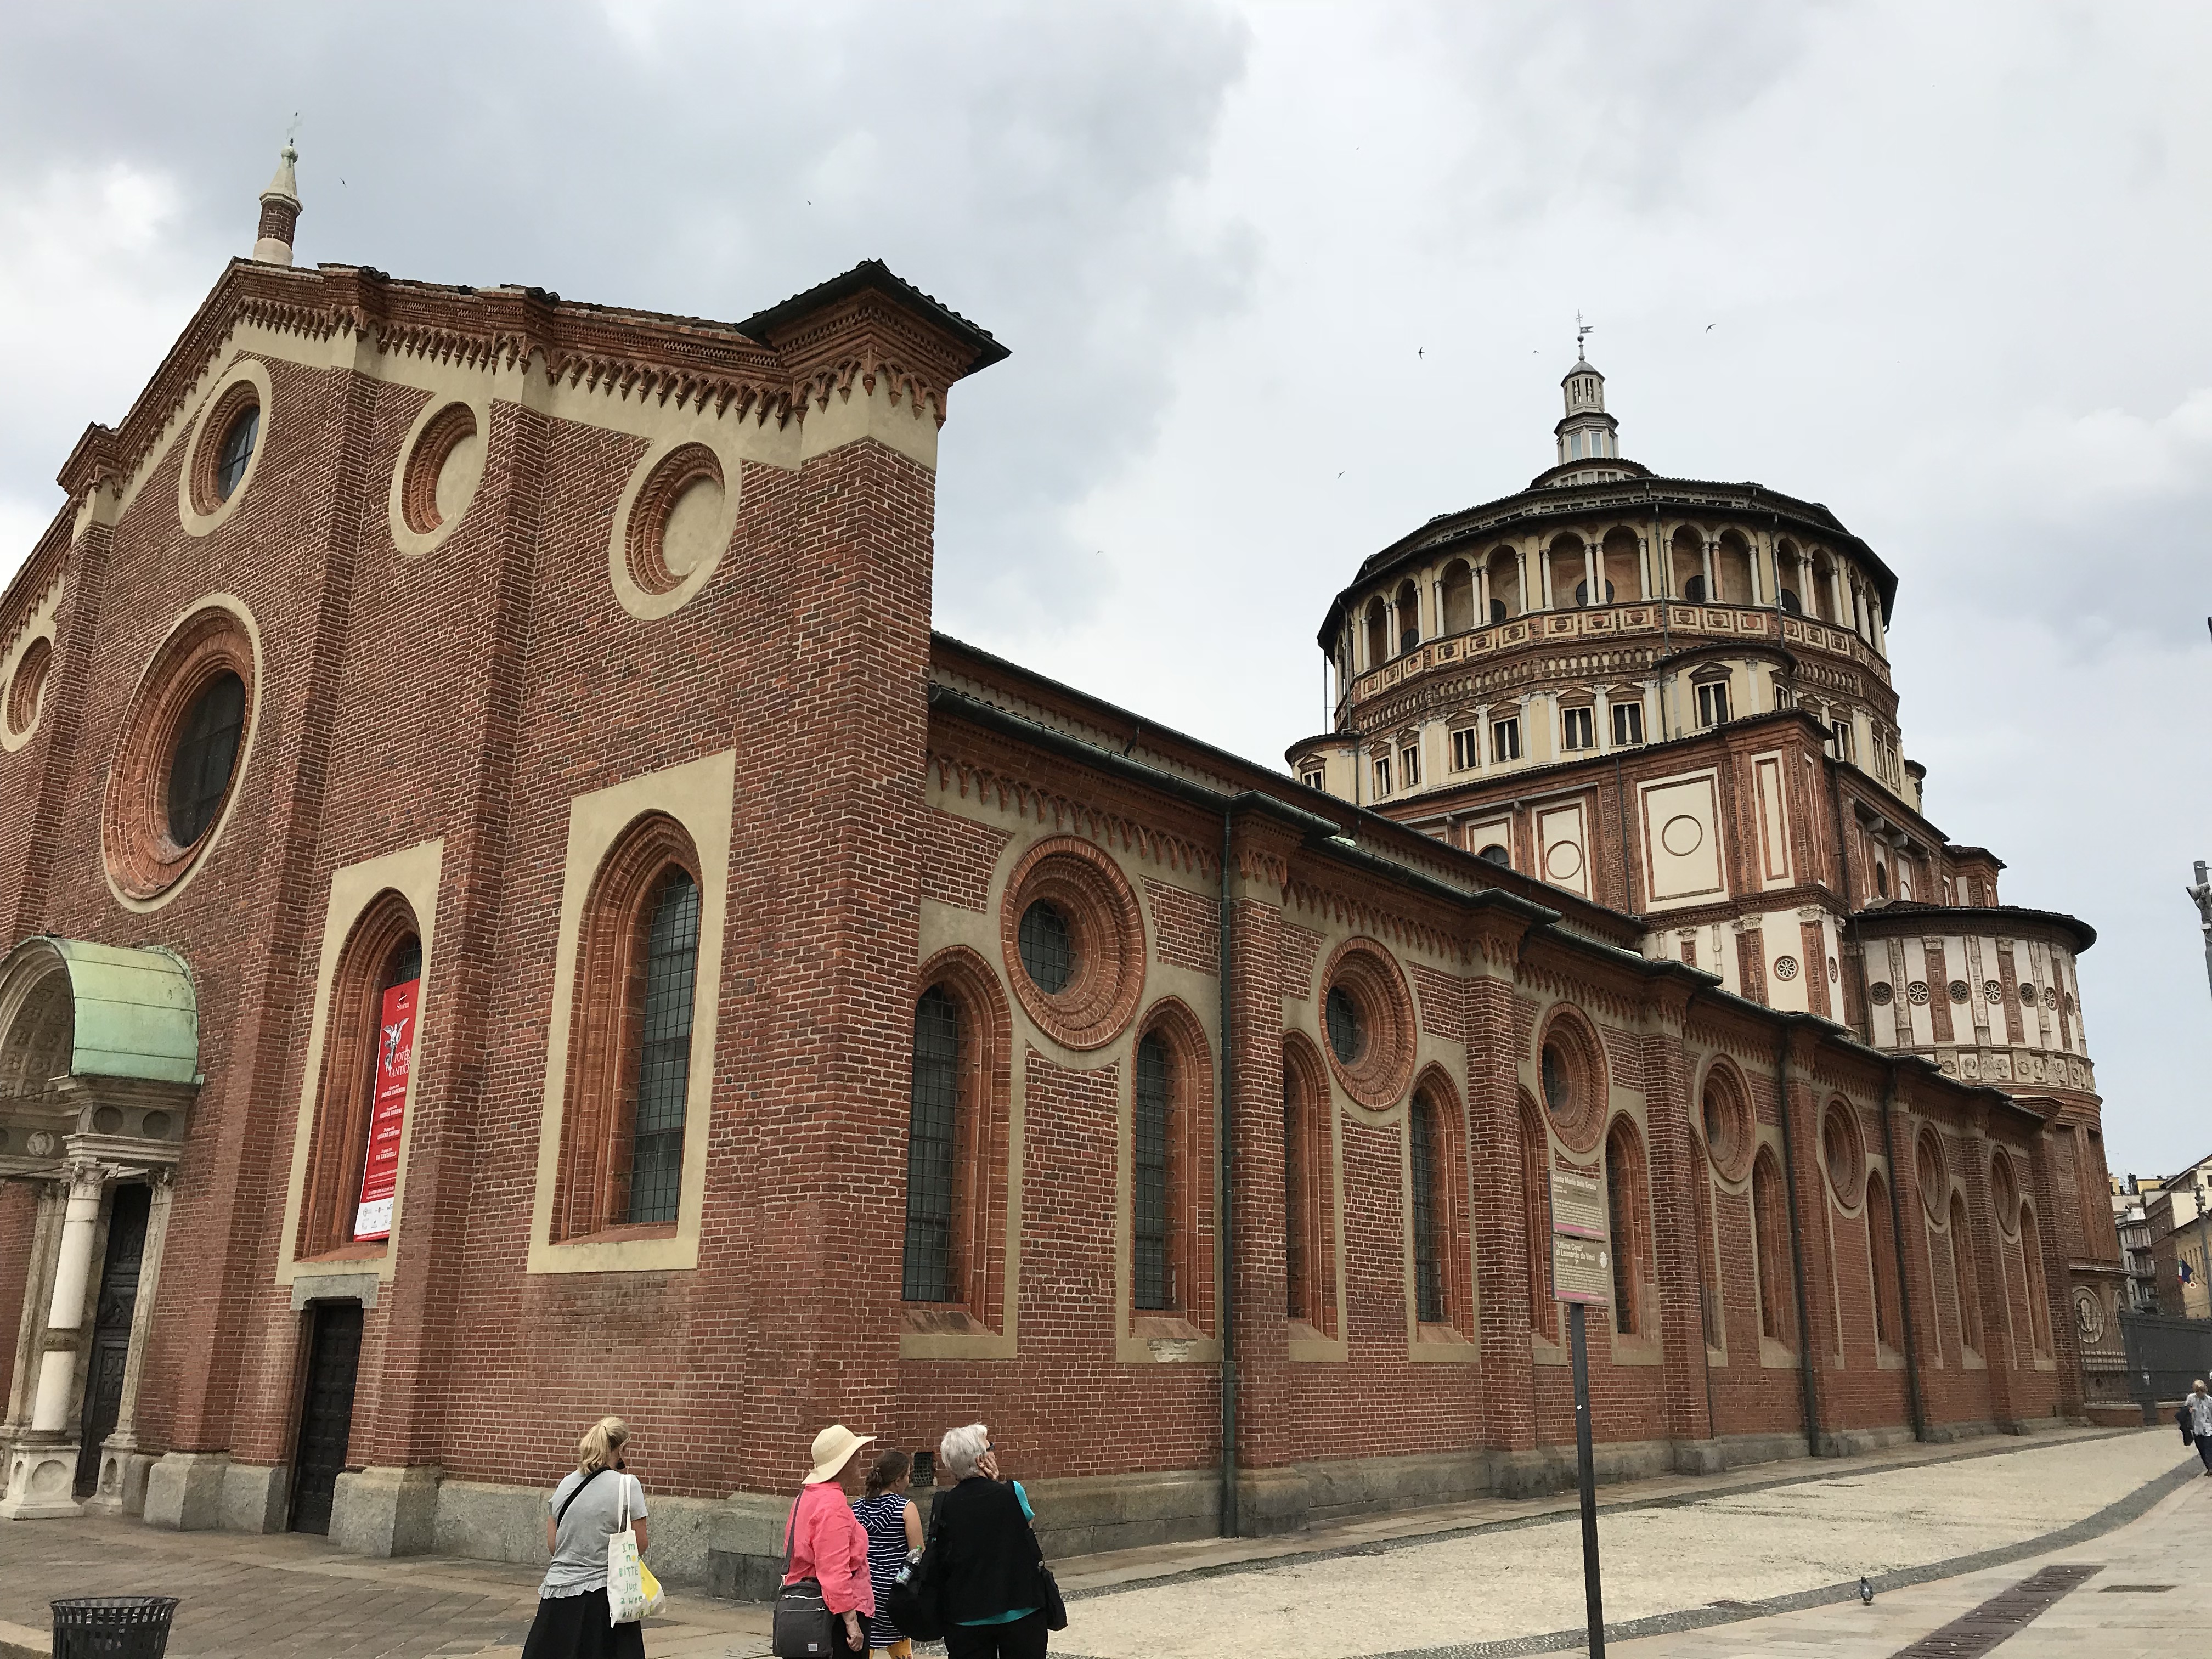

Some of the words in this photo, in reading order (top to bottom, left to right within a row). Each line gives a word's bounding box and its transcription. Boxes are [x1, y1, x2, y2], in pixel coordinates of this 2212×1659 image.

[394, 1049, 410, 1063] POTER
[391, 1064, 409, 1078] ANTIC
[1552, 1173, 1565, 1183] Santa
[1564, 1176, 1576, 1186] Maria
[1560, 1249, 1580, 1259] Leonardo
[1585, 1252, 1595, 1261] Vinci
[622, 1541, 635, 1553] I'm
[628, 1595, 643, 1605] wee
